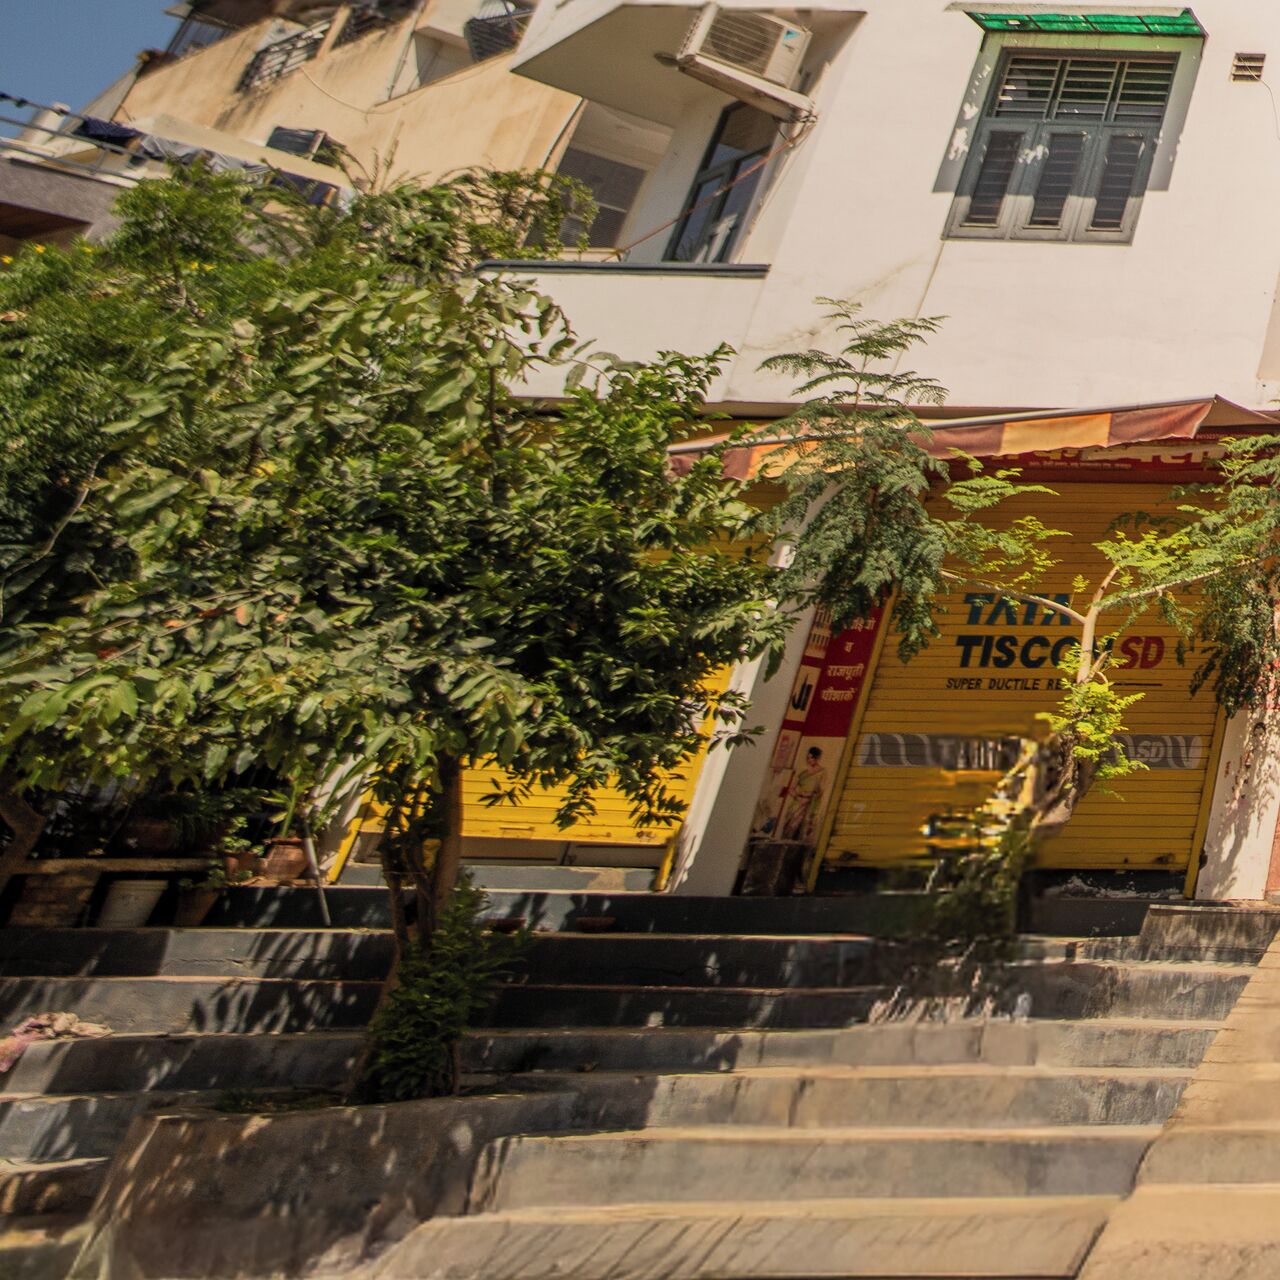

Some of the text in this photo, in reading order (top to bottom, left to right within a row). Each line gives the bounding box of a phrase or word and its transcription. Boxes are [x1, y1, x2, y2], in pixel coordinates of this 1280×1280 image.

[963, 593, 1072, 627] TATA
[1119, 635, 1166, 670] SD
[946, 677, 983, 690] SUPER
[989, 677, 1040, 690] DUCTILE
